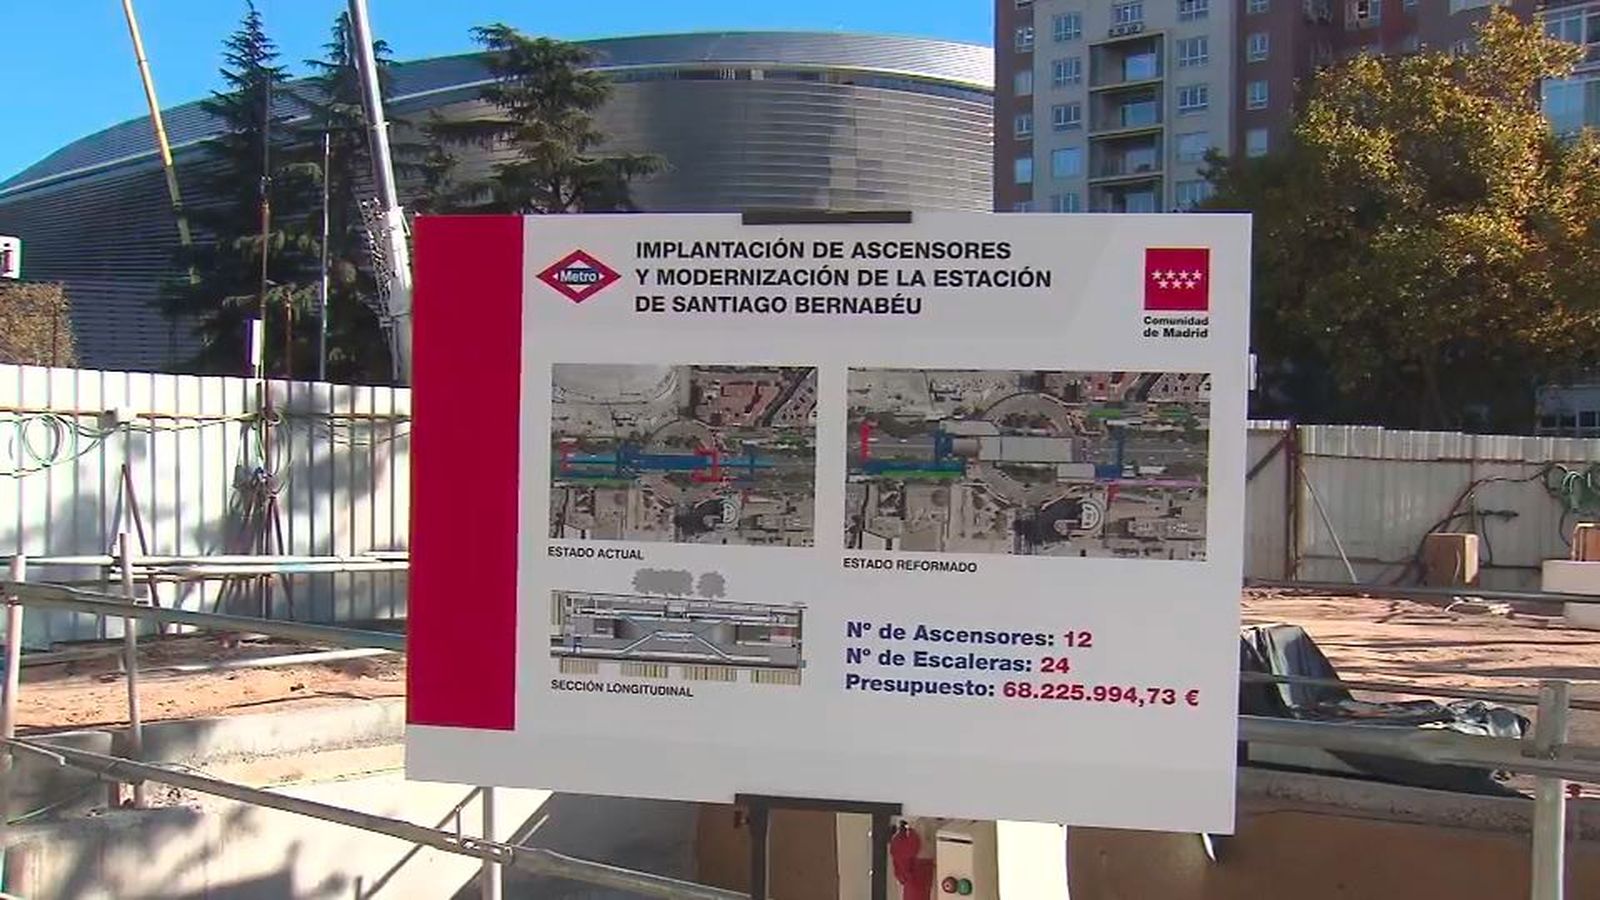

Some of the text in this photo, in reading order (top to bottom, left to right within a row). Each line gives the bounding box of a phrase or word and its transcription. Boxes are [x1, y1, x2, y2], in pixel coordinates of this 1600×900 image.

[636, 237, 1012, 260] IMPLANTACIÓN DE ASCENSORES
[560, 270, 597, 282] Metro
[635, 265, 1051, 288] Y MODERNIZACIÓN DE LA ESTACIÓN
[635, 293, 922, 315] DE SANTIAGO BERNABÉU
[1143, 316, 1209, 326] Comunidad
[1142, 327, 1208, 338] de Madrid
[547, 546, 645, 560] ESTADO ACTUAL
[842, 557, 978, 573] ESTADO REFORMADO
[878, 623, 907, 641] de
[912, 624, 1055, 647] Ascensores:
[1063, 630, 1093, 648] 12
[877, 649, 906, 667] de
[913, 650, 1032, 673] Escaleras:
[1040, 656, 1071, 674] 24
[550, 679, 695, 698] SECCIÓN LONGITUDINAL
[845, 673, 1200, 707] Presupuesto: 68.225.994,73 €
